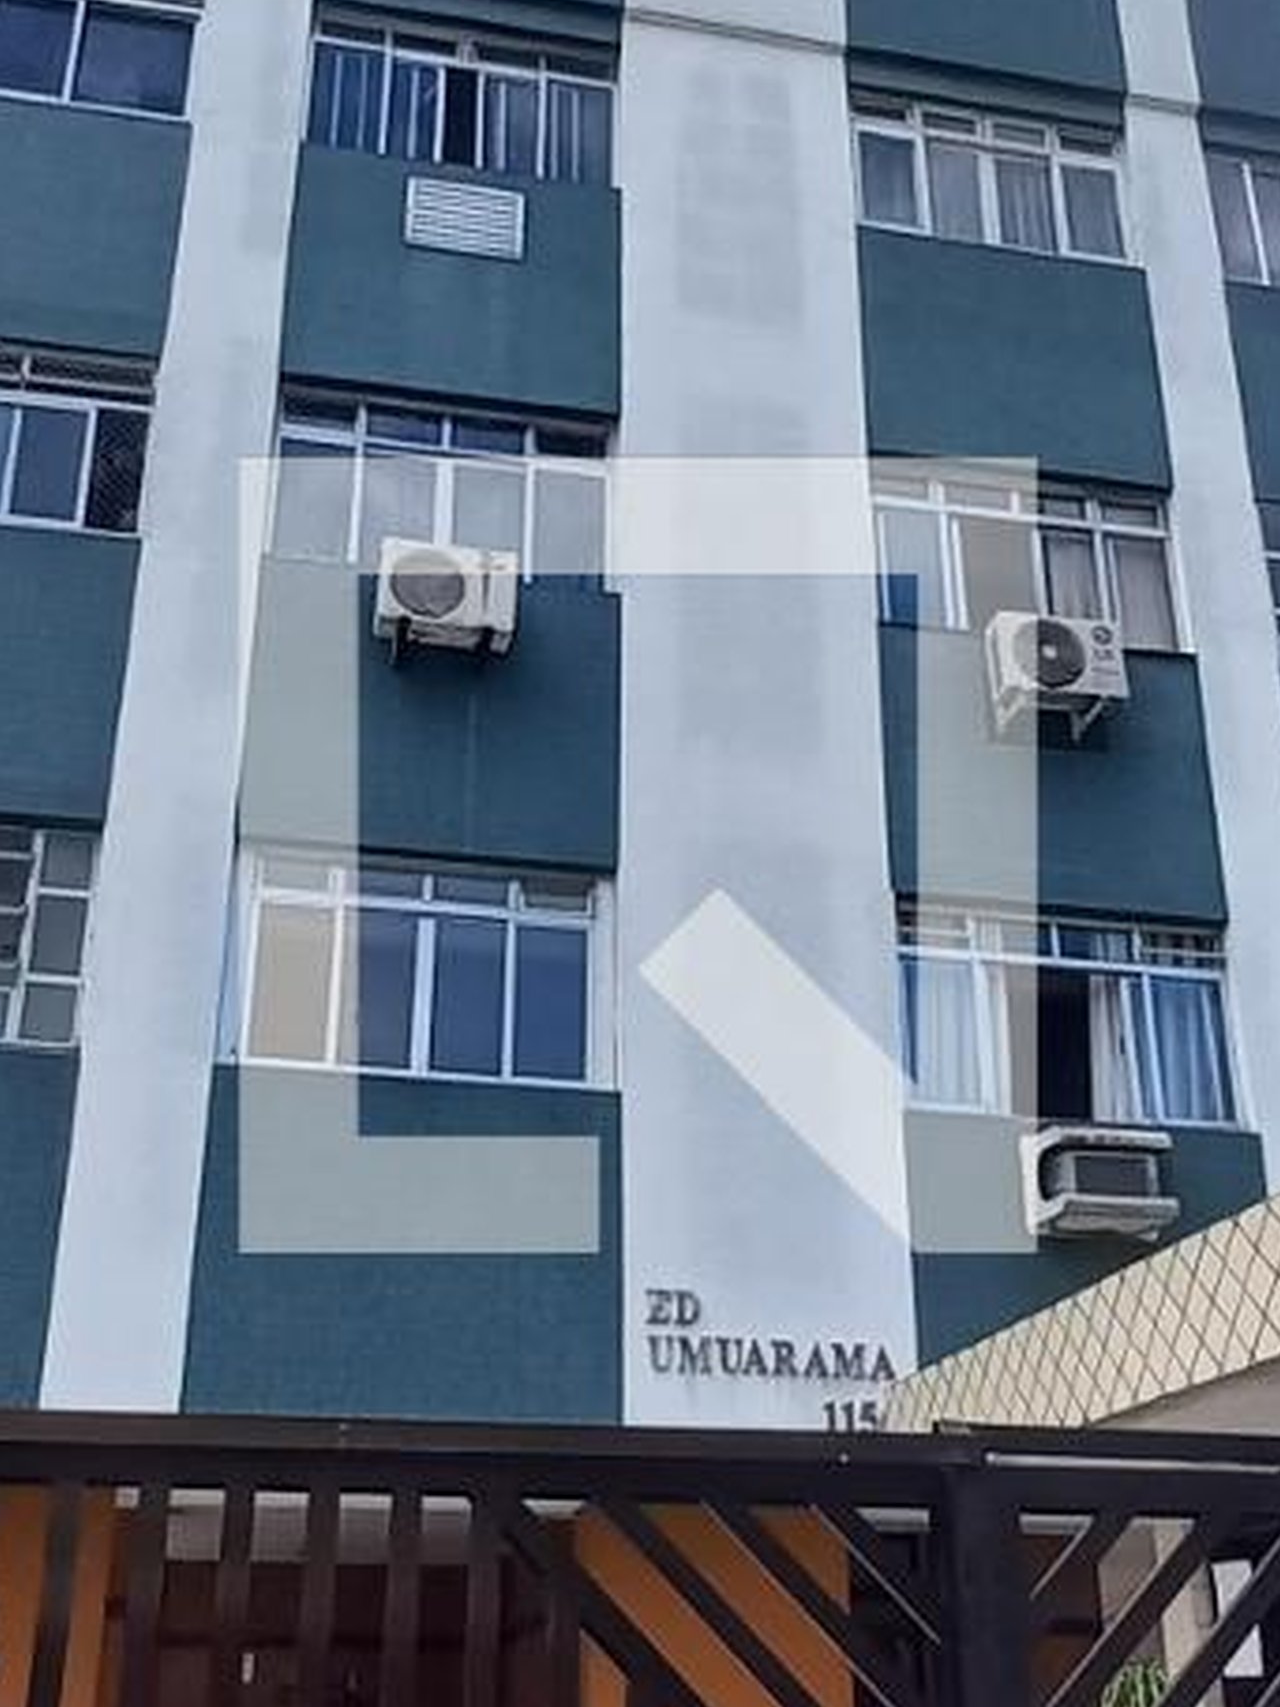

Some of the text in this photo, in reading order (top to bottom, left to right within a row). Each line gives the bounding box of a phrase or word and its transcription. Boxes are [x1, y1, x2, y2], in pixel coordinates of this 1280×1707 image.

[645, 1288, 701, 1326] ED
[647, 1335, 896, 1381] UMUARAMA
[823, 1400, 878, 1433] 115
